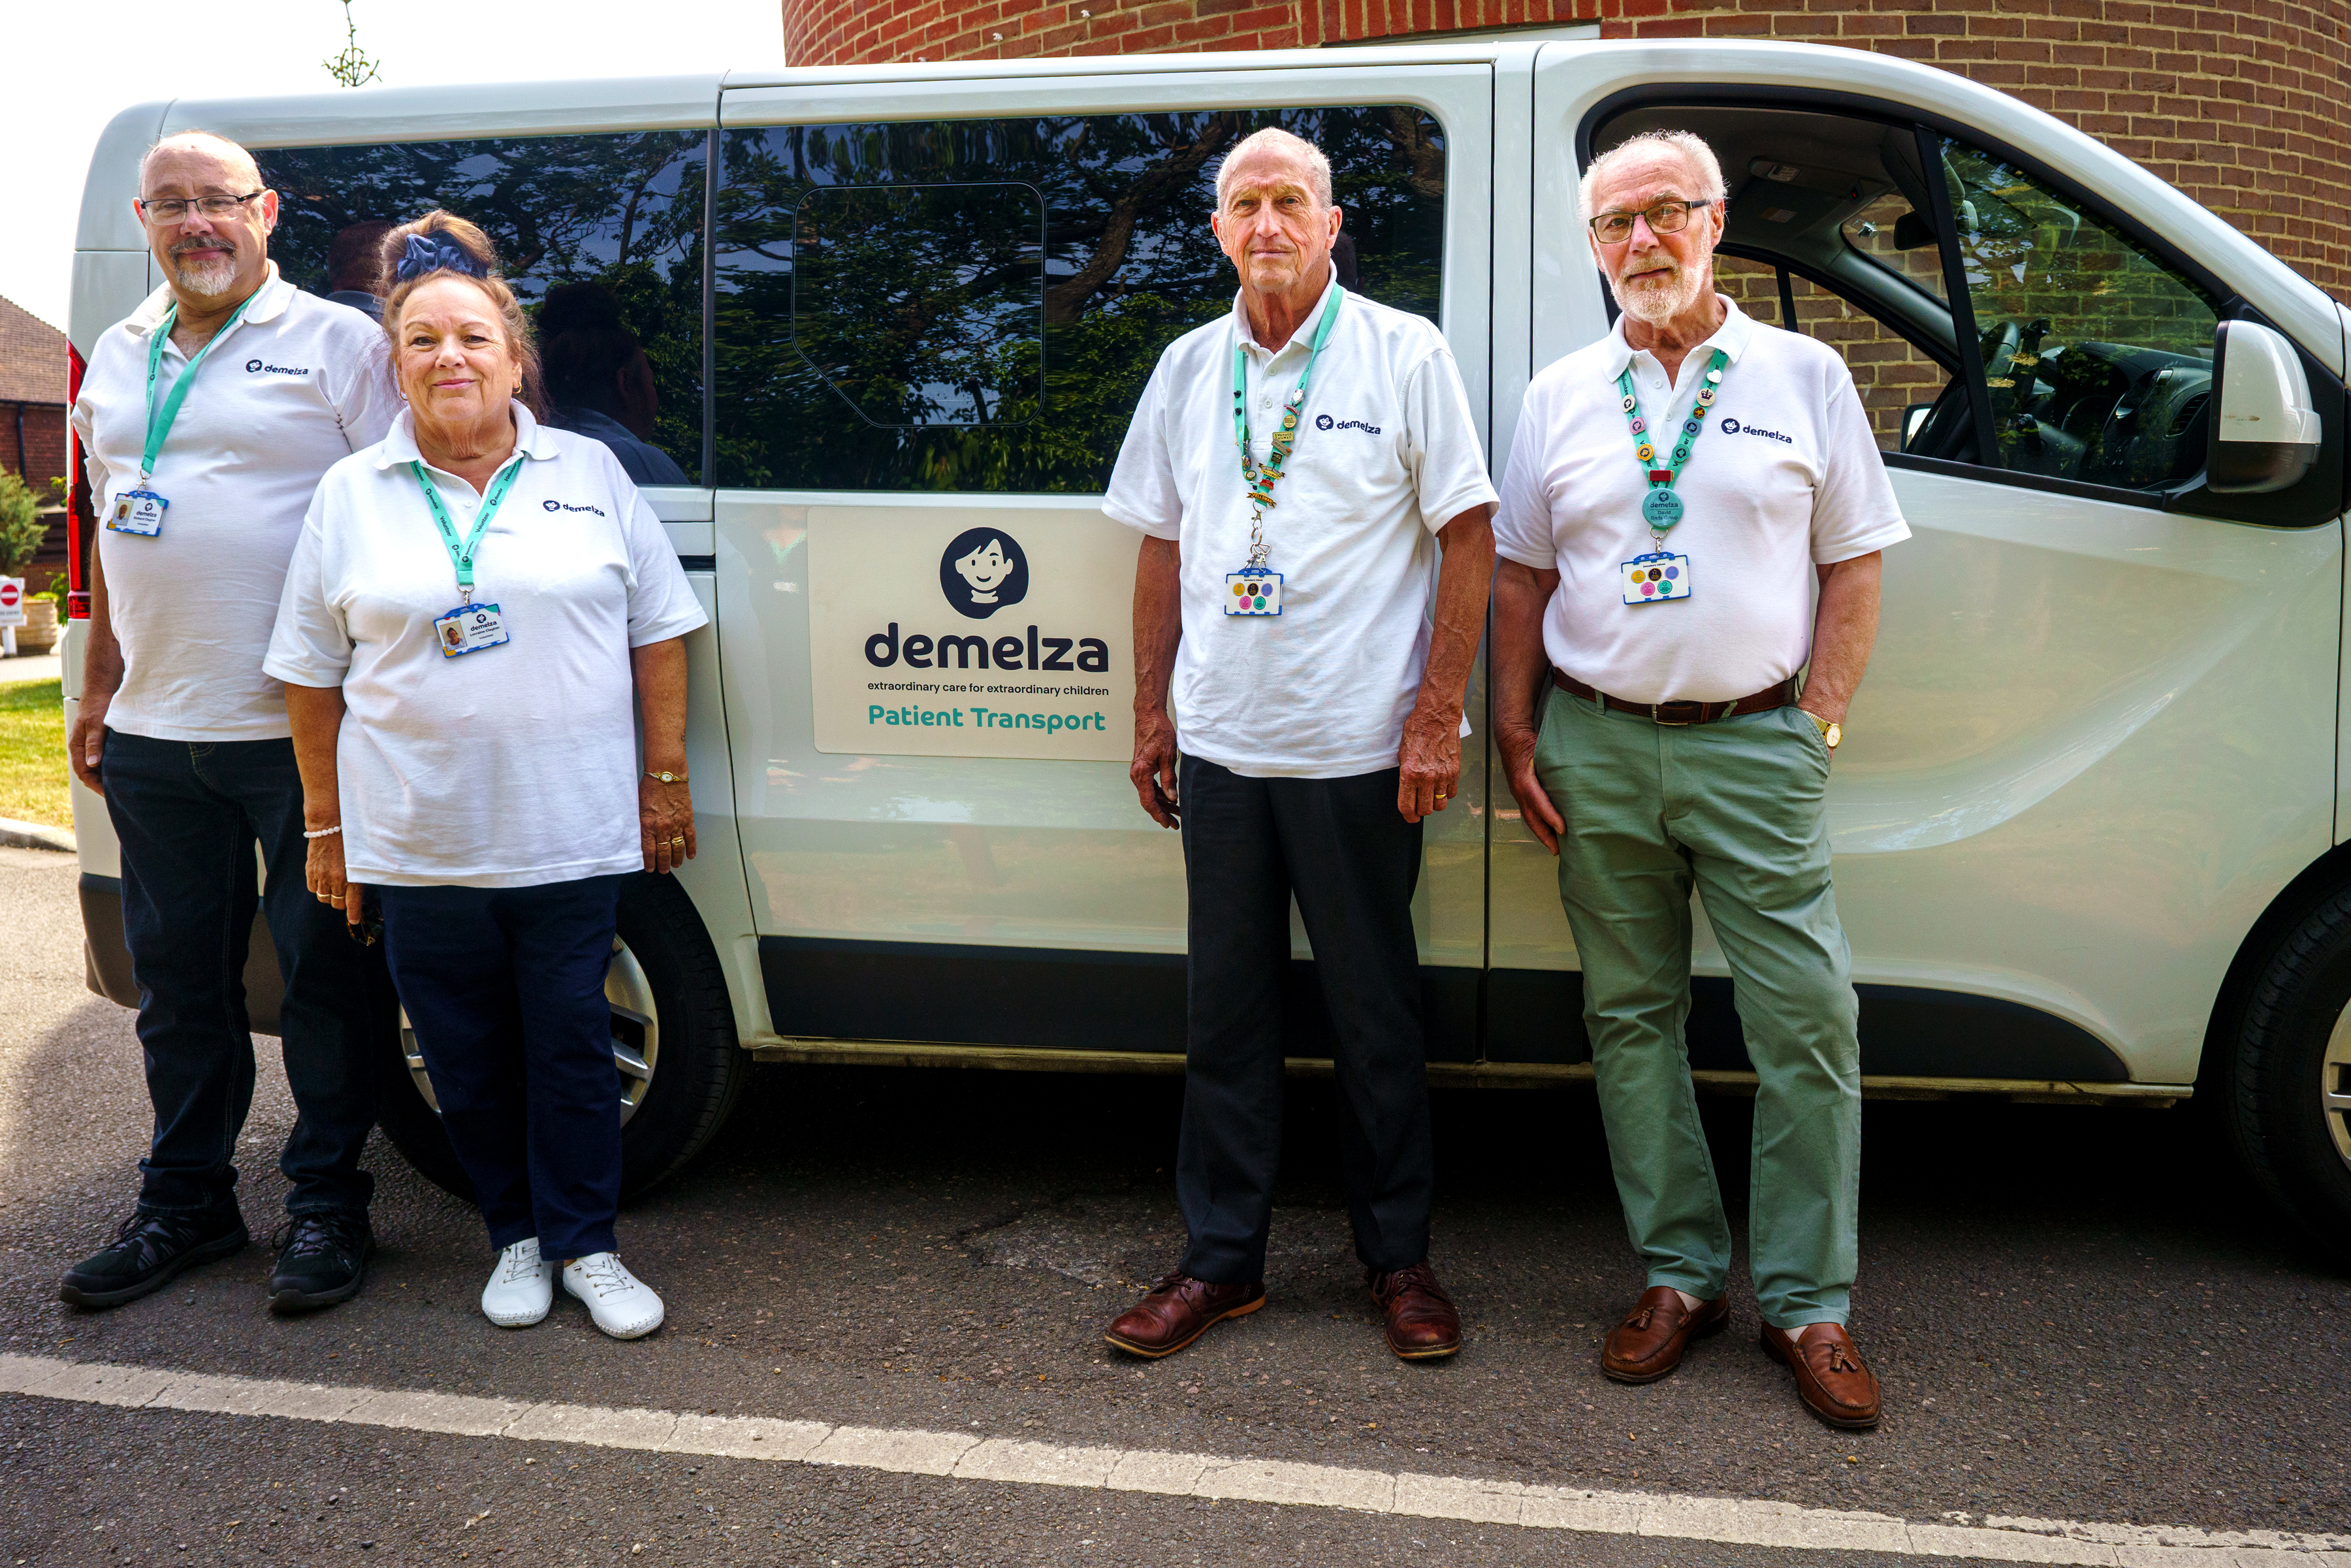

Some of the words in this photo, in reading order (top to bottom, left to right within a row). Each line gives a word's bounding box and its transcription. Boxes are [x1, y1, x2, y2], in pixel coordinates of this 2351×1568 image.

[264, 364, 308, 375] demelza
[1337, 421, 1381, 434] demelza
[1742, 425, 1792, 443] demelza
[428, 494, 438, 509] demelza
[1253, 493, 1273, 504] FELLSMAN
[563, 504, 605, 517] demelza
[440, 515, 451, 536] Volunteer
[475, 513, 490, 533] Volunteer
[470, 620, 497, 632] demelza
[865, 622, 1109, 673] demelza
[867, 681, 940, 694] extraordinary
[969, 683, 984, 692] for
[987, 684, 1061, 697] extraordinary
[1063, 686, 1109, 696] children
[869, 705, 964, 728] Patient
[970, 707, 1106, 735] Transport
